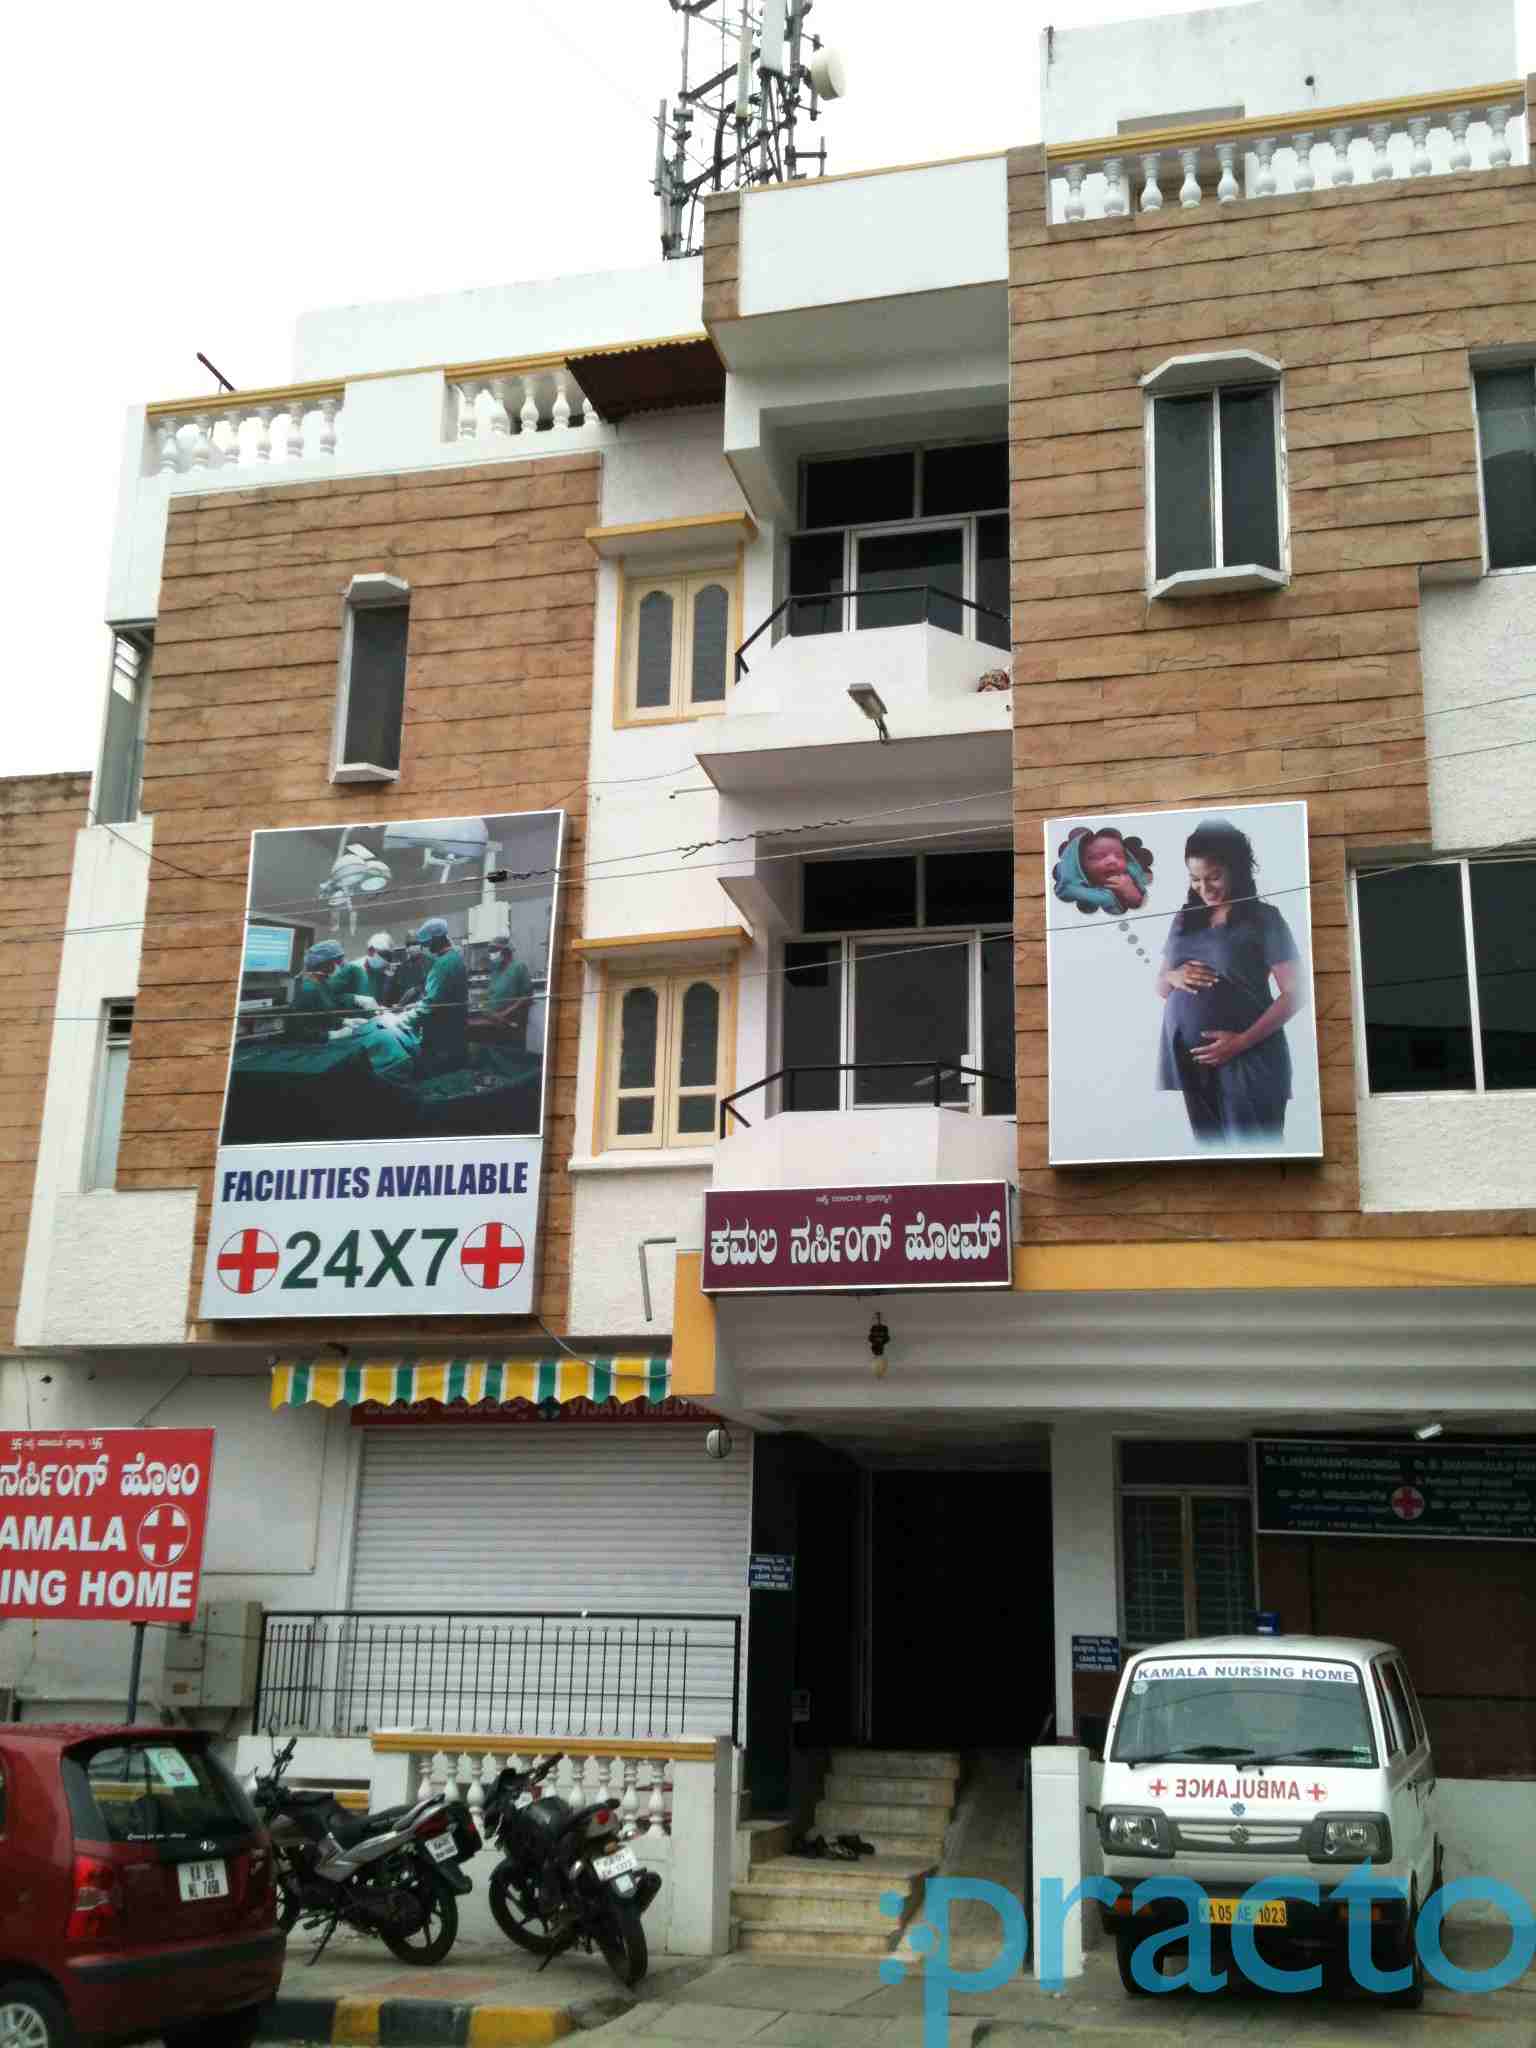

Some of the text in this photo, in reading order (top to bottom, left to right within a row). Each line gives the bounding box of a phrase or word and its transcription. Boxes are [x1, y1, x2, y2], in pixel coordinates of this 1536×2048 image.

[221, 1161, 529, 1203] FACILITIES AVAILABLE
[711, 1210, 1001, 1265] ಕಮಲ ನರ್ಸಿಂಗ್ ಹೋಮ್
[281, 1227, 459, 1290] 24X7
[79, 1570, 193, 1608] HOME
[1137, 1666, 1354, 1682] KAMALA NURSING HOME
[1218, 1904, 1232, 1921] 05
